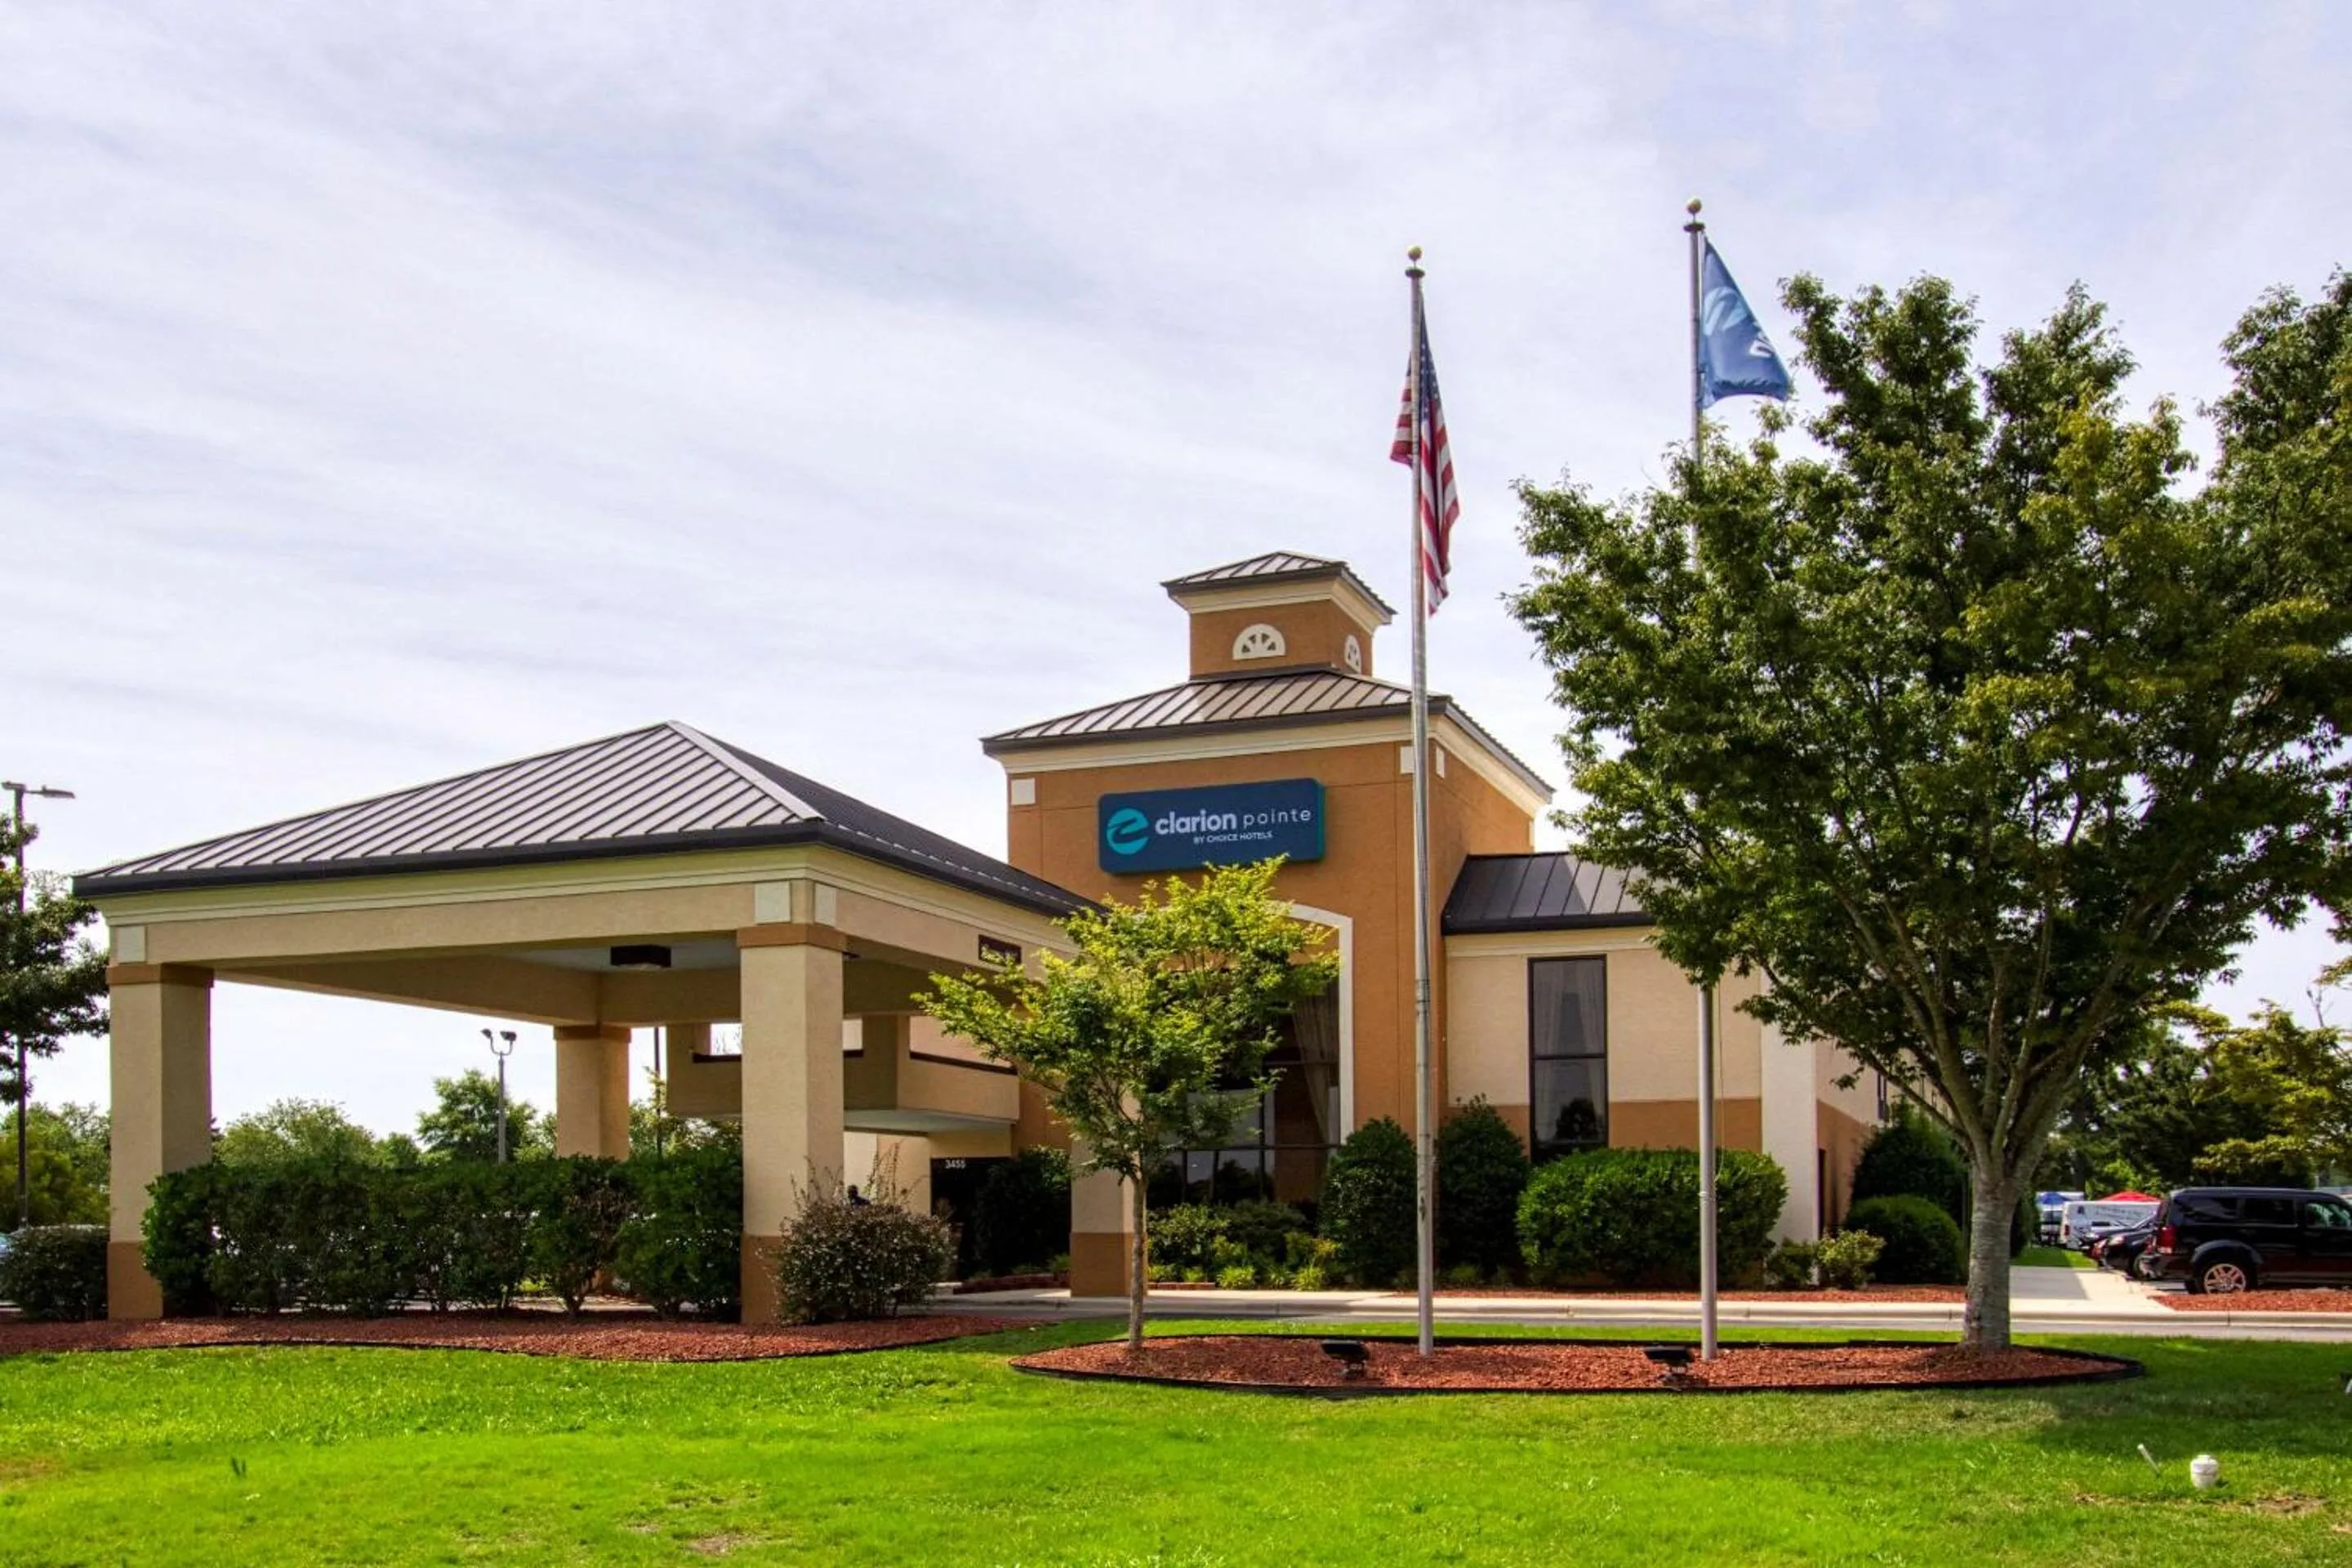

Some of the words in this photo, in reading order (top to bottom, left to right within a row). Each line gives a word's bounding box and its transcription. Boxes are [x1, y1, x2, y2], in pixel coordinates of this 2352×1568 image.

[1155, 809, 1237, 835] clarion
[1243, 808, 1312, 828] pointe
[1207, 834, 1238, 843] CHOICE
[1240, 831, 1273, 840] HOTELS
